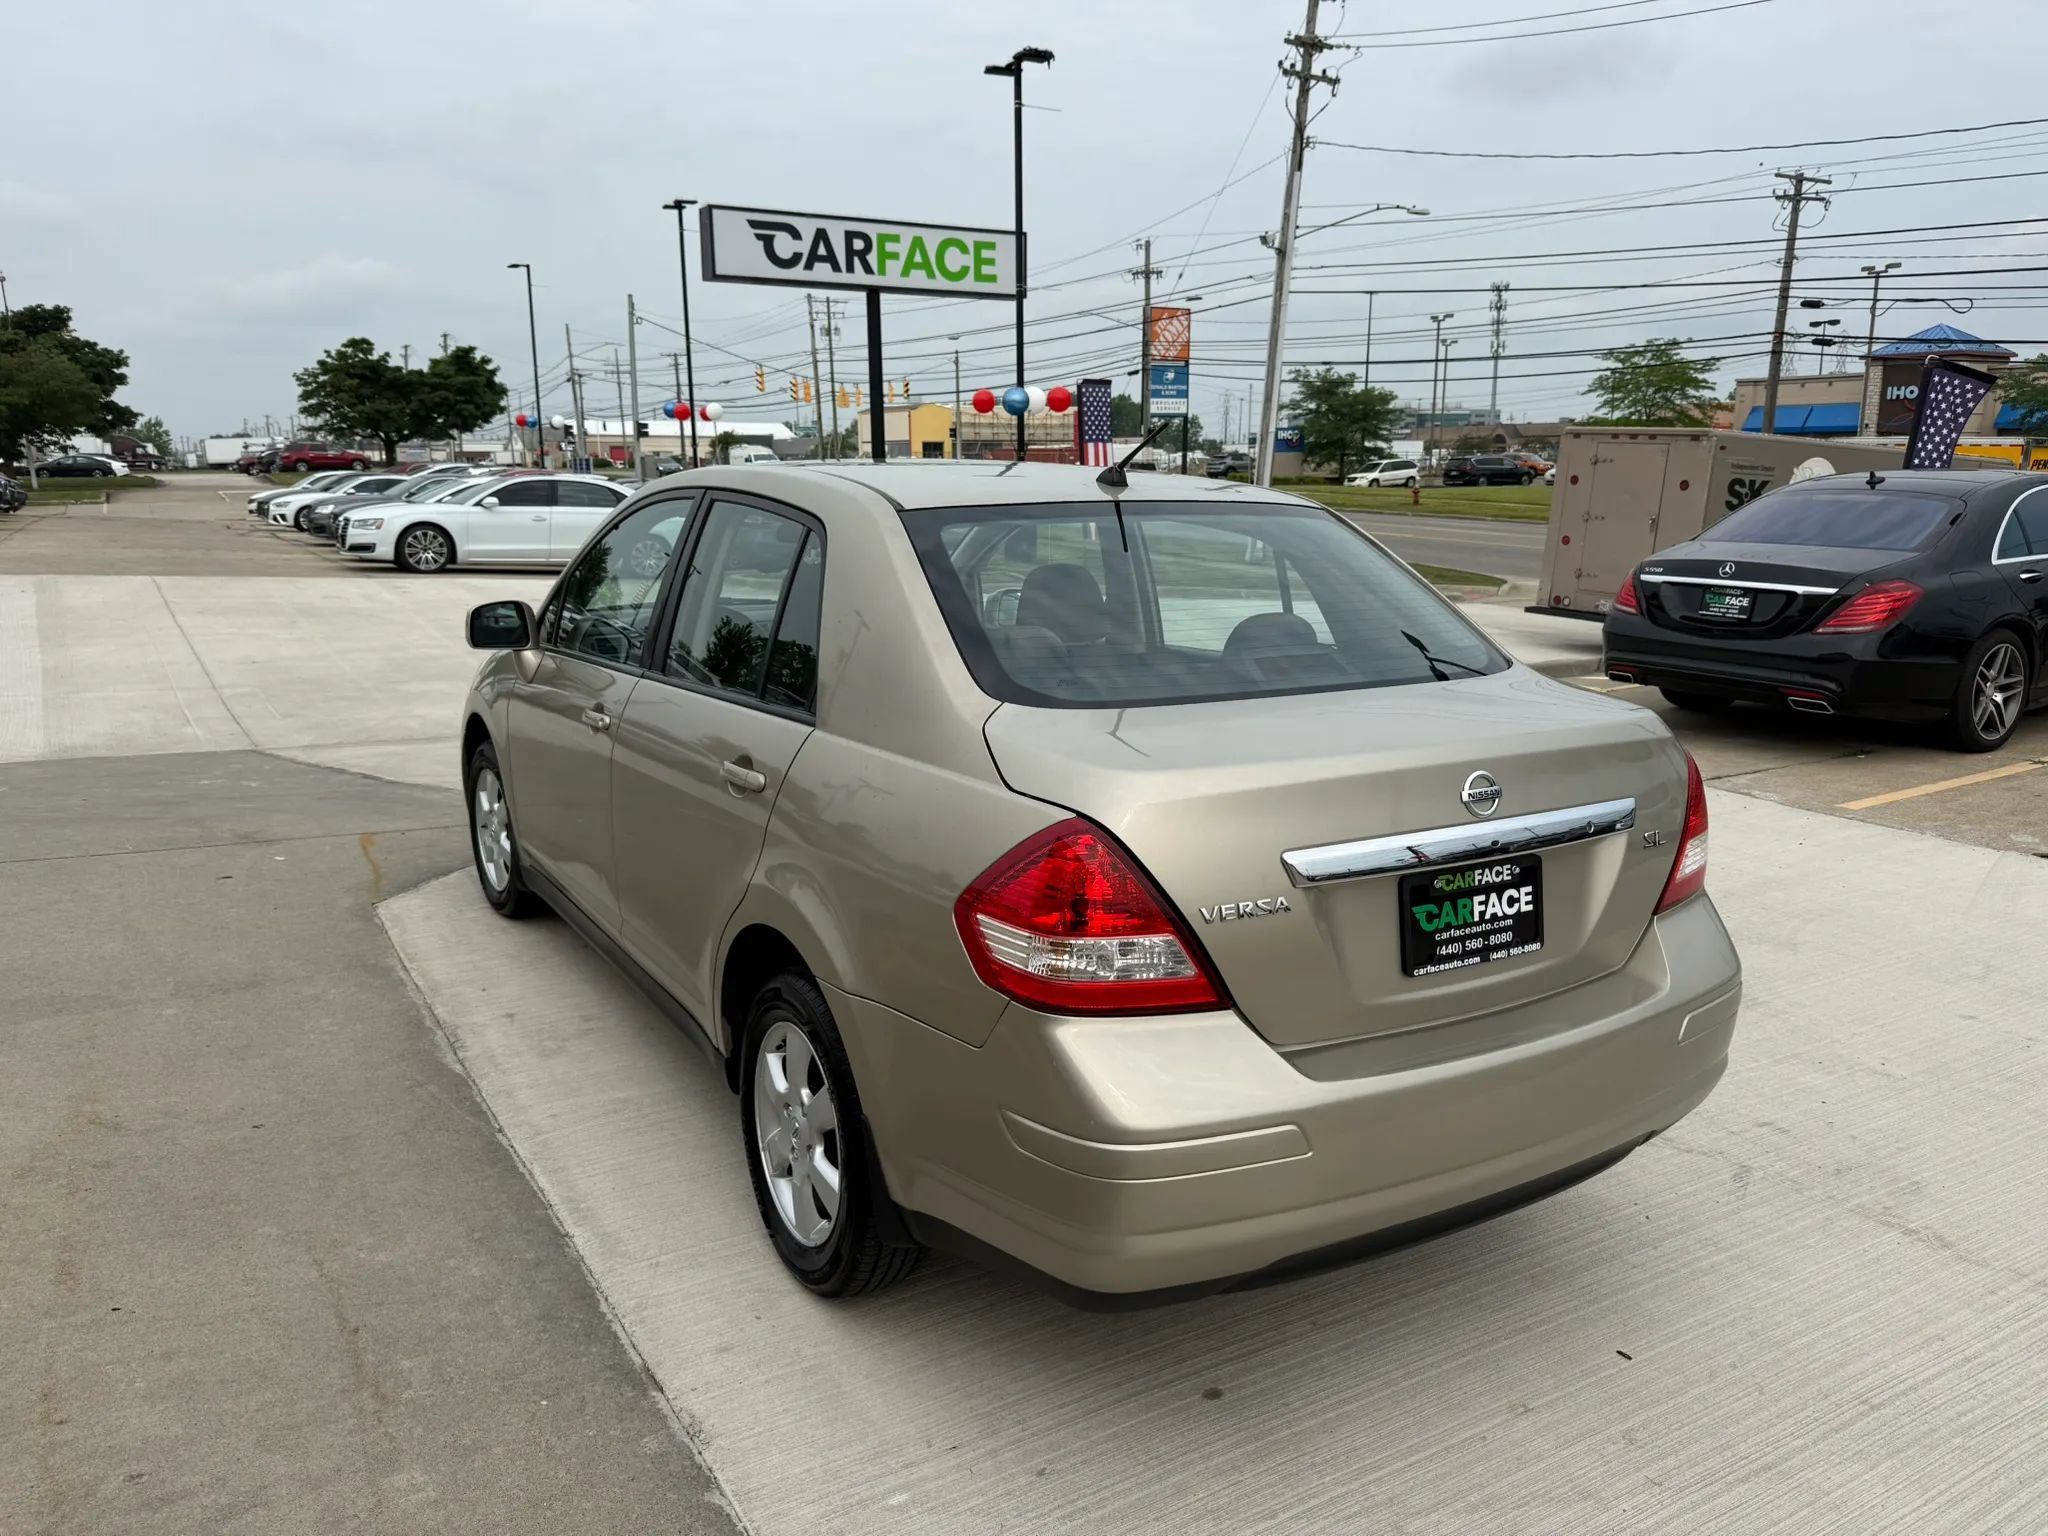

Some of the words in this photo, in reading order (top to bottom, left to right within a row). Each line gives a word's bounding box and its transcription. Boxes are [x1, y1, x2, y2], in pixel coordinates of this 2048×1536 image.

[746, 219, 998, 283] CARFACE
[1886, 385, 1920, 400] IHO
[1467, 788, 1500, 800] NISSAN
[1643, 830, 1667, 848] SL
[1437, 864, 1512, 891] CARFACE
[1199, 896, 1291, 924] VERSA
[1411, 886, 1534, 932] CARFACE
[1435, 918, 1513, 941] carfaceauto.com
[1413, 956, 1481, 976] carfaceauto.com
[1489, 950, 1508, 962] (440)
[1509, 942, 1541, 956] 560-8080
[1436, 942, 1463, 956] (440)
